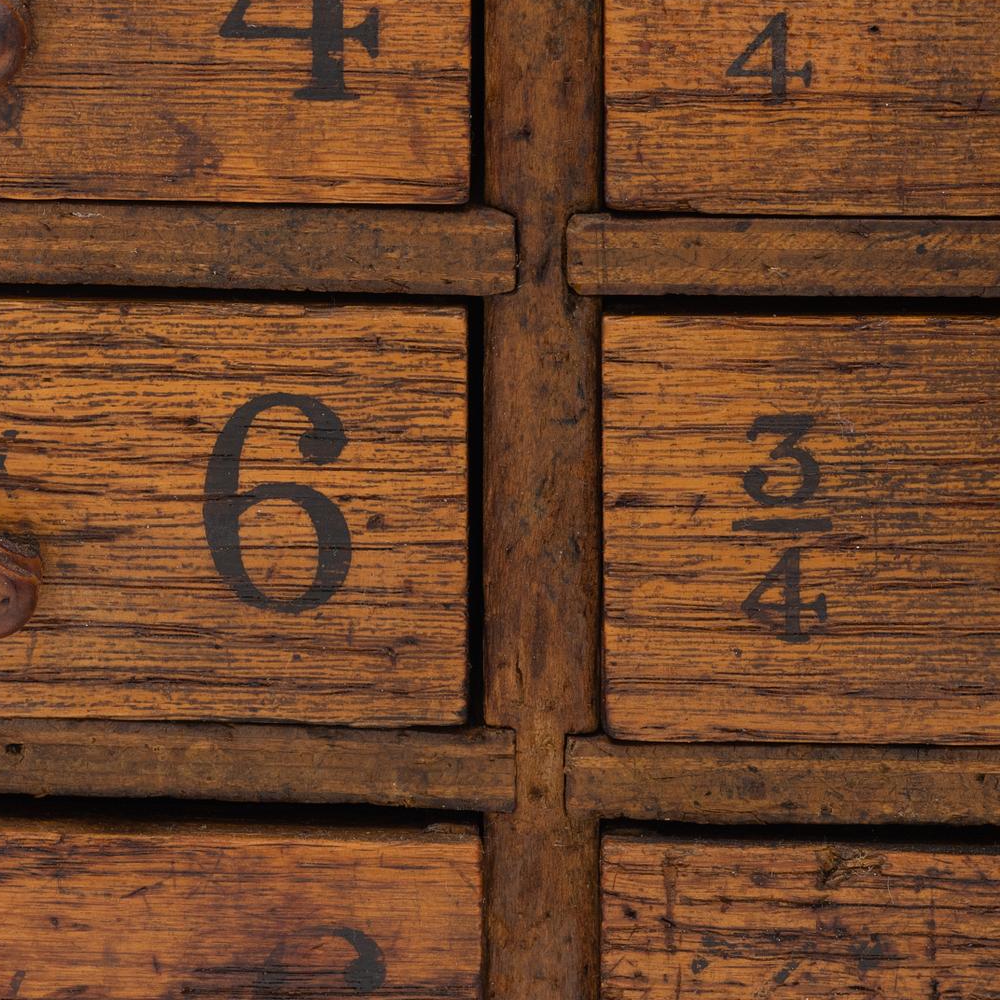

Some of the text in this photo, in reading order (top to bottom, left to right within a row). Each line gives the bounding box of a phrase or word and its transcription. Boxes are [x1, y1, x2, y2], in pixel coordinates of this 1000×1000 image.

[724, 11, 815, 107] 4
[203, 392, 353, 614] 6
[742, 413, 820, 506] 3
[740, 546, 828, 644] 4
